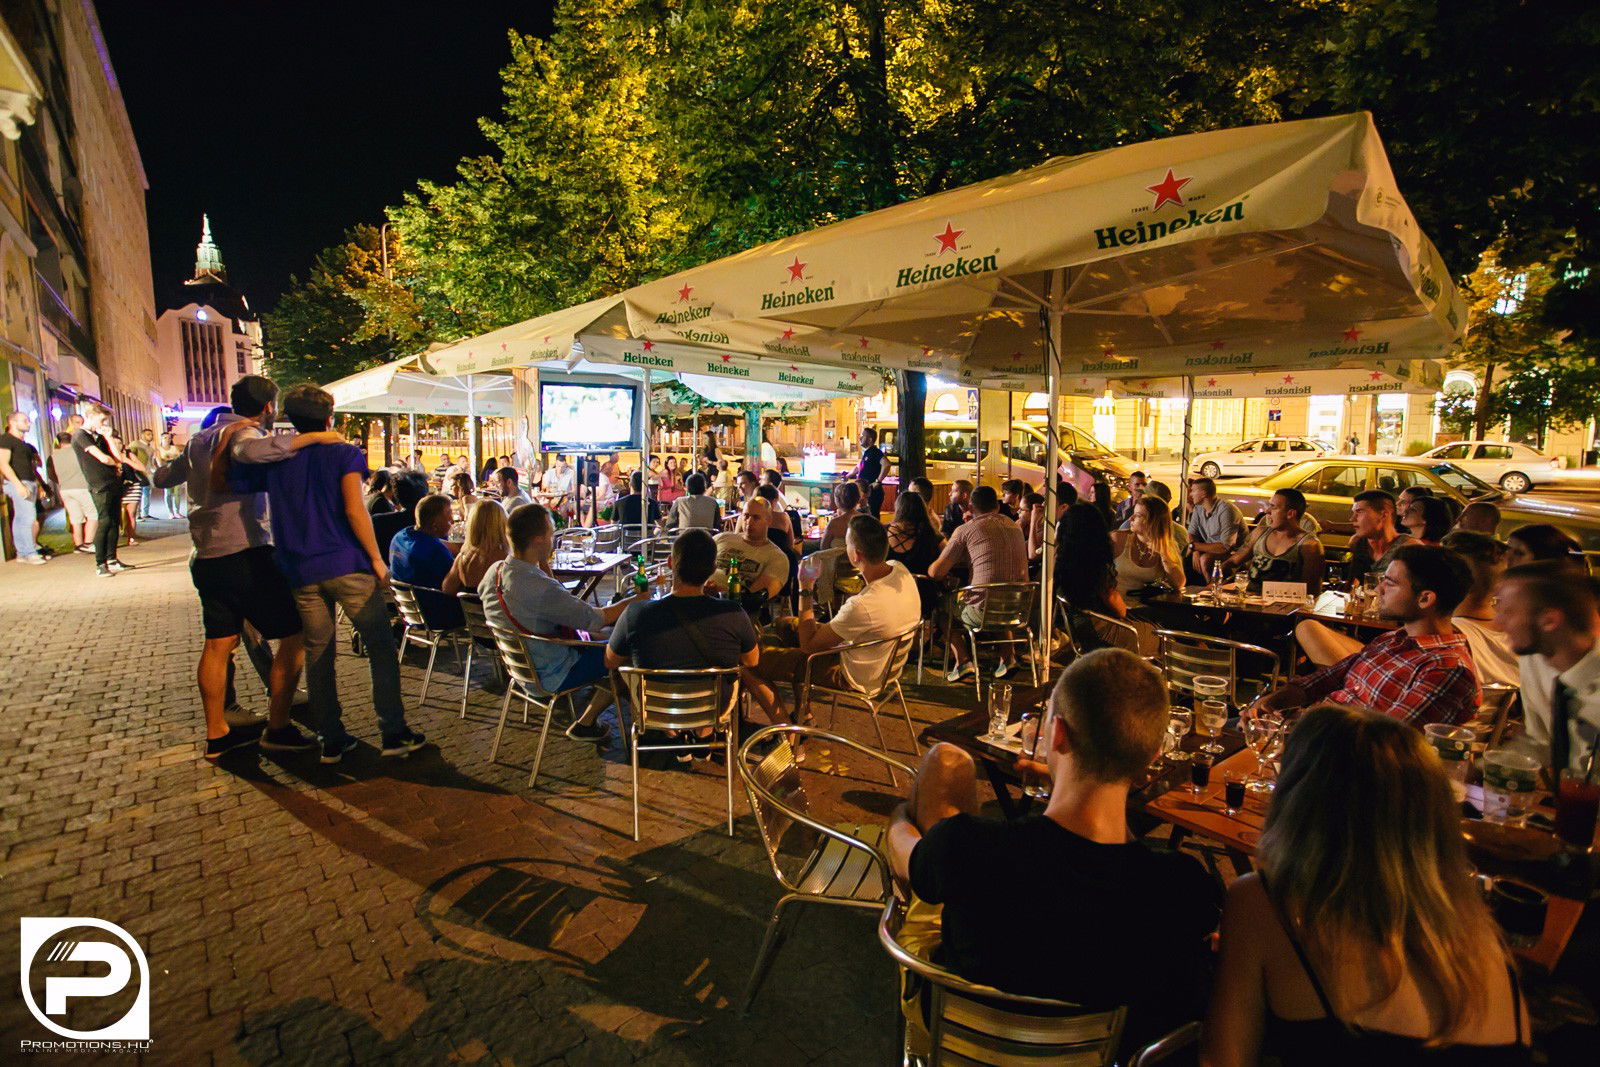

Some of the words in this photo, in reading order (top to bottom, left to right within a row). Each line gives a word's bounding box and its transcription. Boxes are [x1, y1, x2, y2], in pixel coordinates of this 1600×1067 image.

[1094, 201, 1245, 250] Heineken
[896, 255, 998, 288] Heineken
[760, 286, 835, 310] Heineken
[654, 305, 712, 325] Heineken
[623, 352, 674, 368] Heineken
[707, 362, 750, 377] Heineken
[778, 372, 815, 385] Heineken
